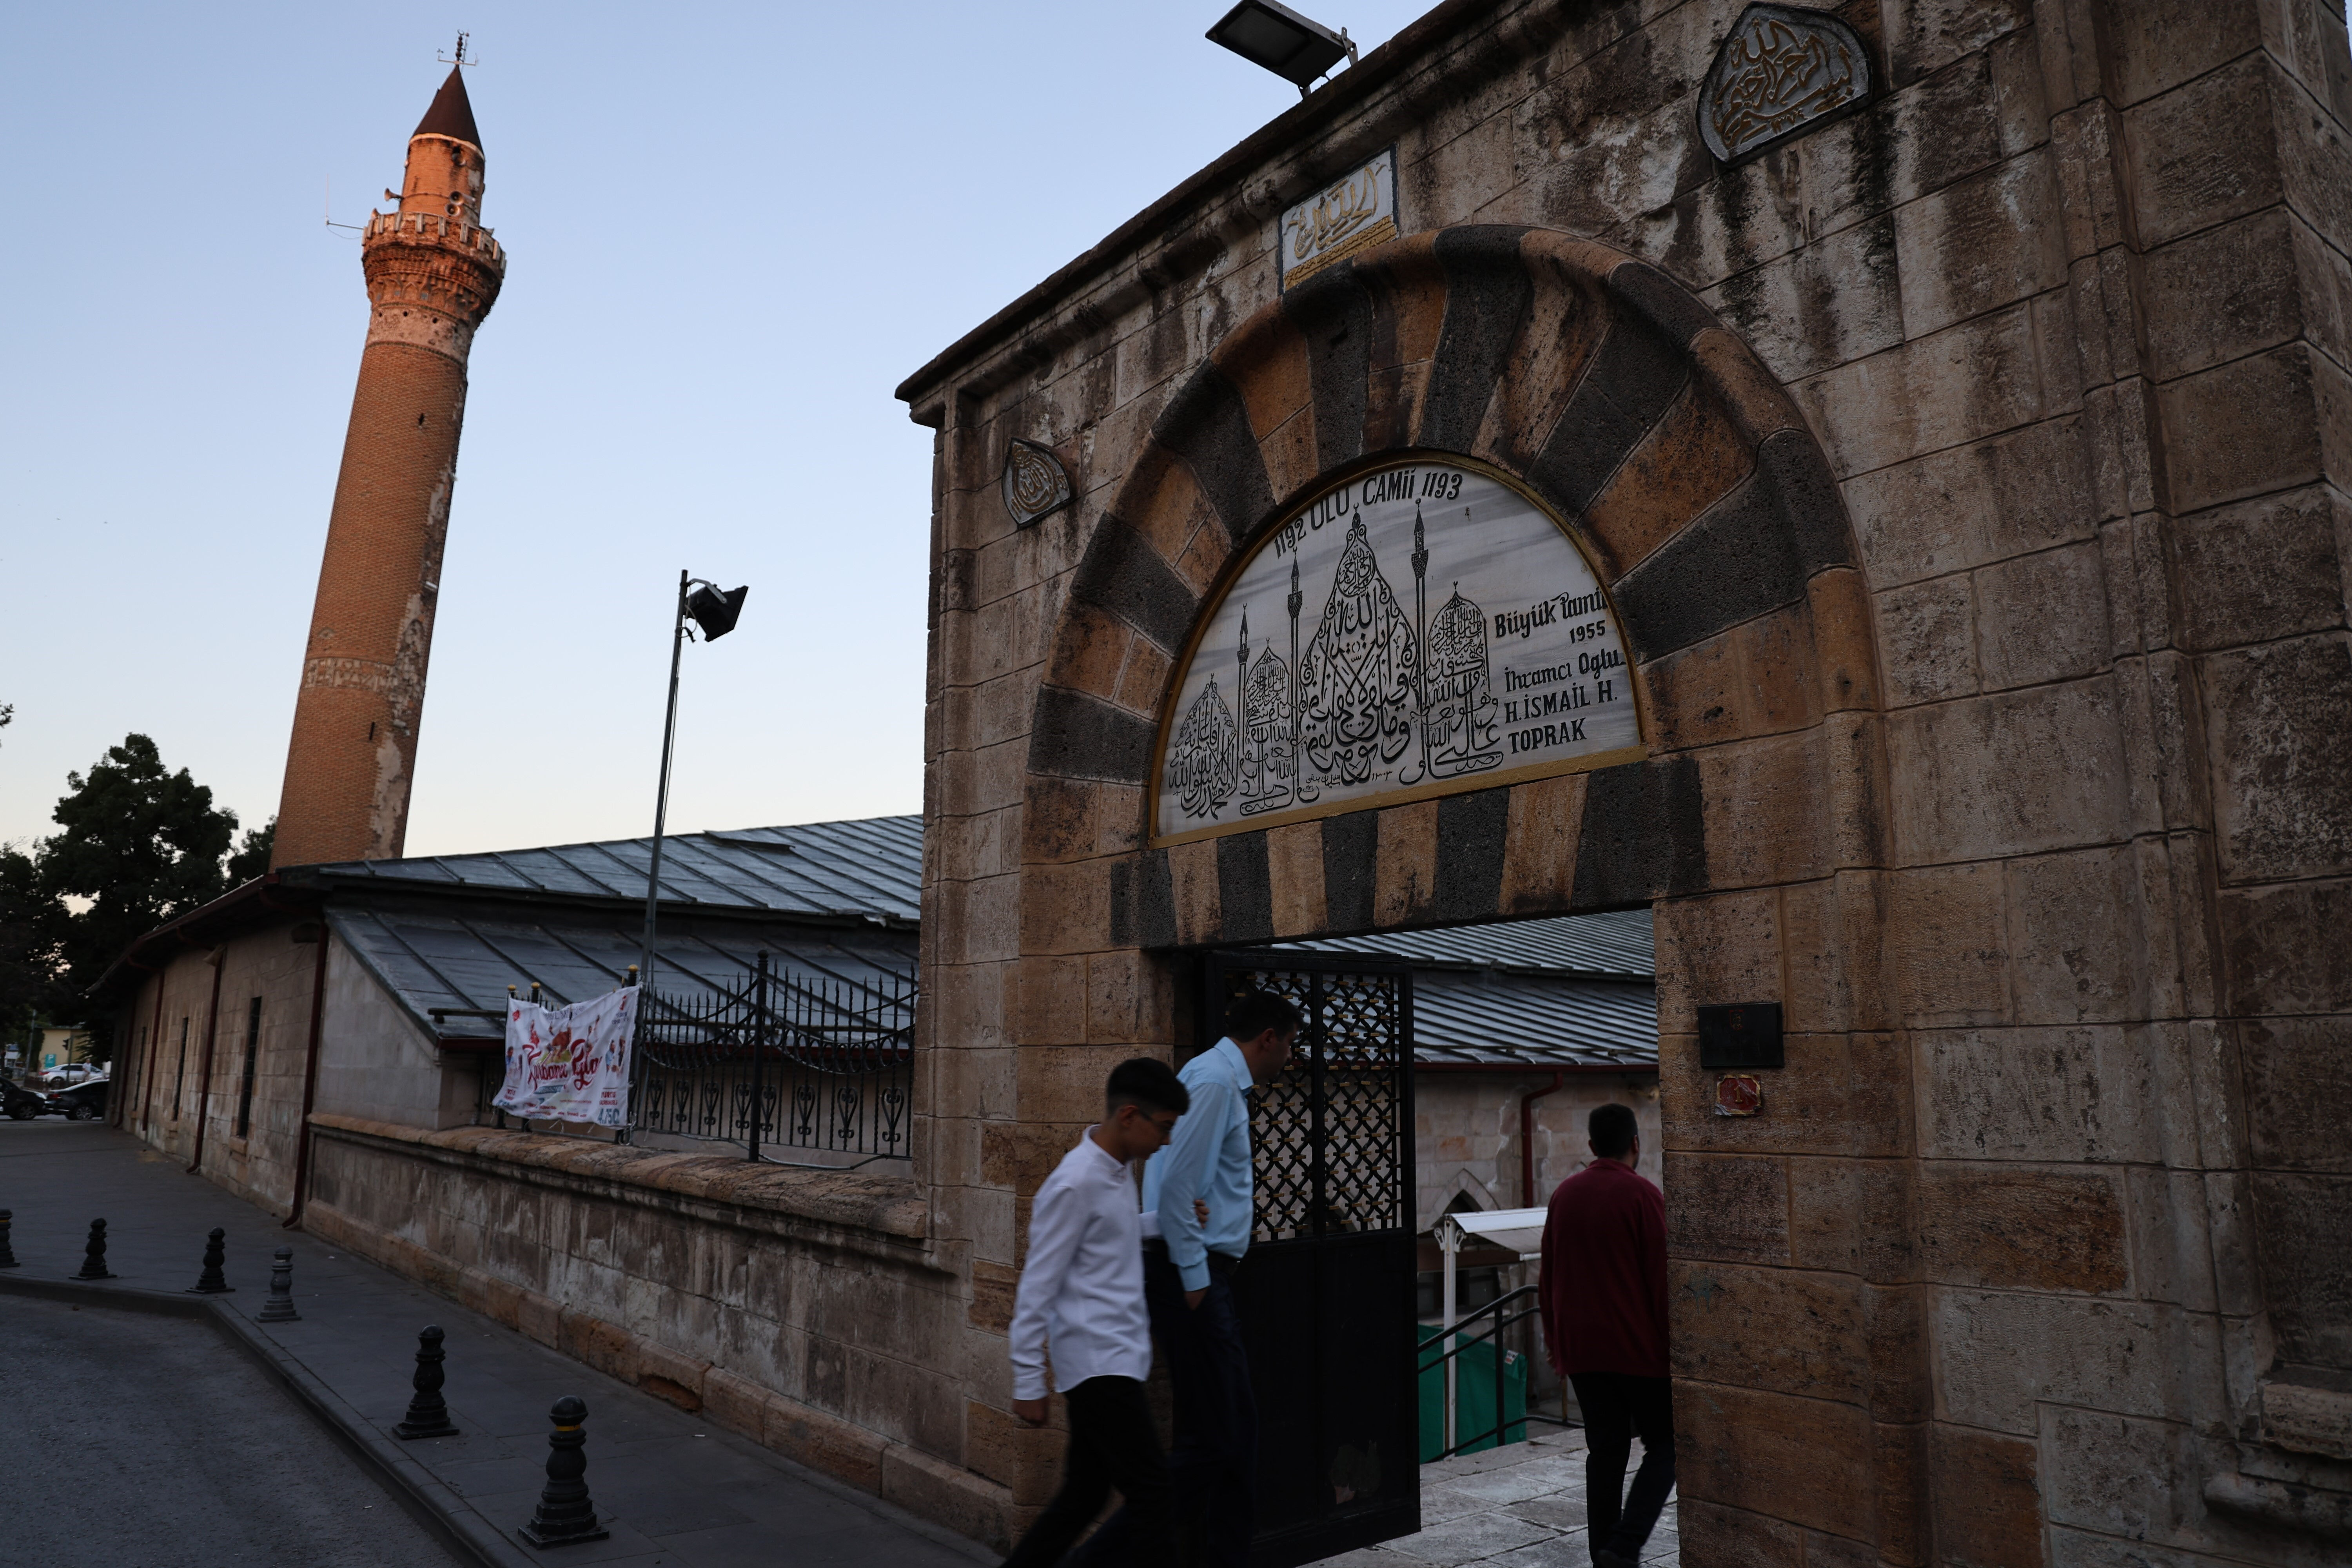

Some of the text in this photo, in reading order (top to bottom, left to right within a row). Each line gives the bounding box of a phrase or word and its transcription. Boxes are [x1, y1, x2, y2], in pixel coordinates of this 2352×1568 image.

[1274, 517, 1307, 559] 1192
[1310, 487, 1349, 531] ULU
[1421, 472, 1463, 501] 1193
[1495, 601, 1556, 639] Büyük
[1570, 619, 1606, 644] 1955
[1597, 679, 1617, 704] H.
[1508, 717, 1588, 754] TOPRAK
[1733, 1086, 1743, 1103] 1
